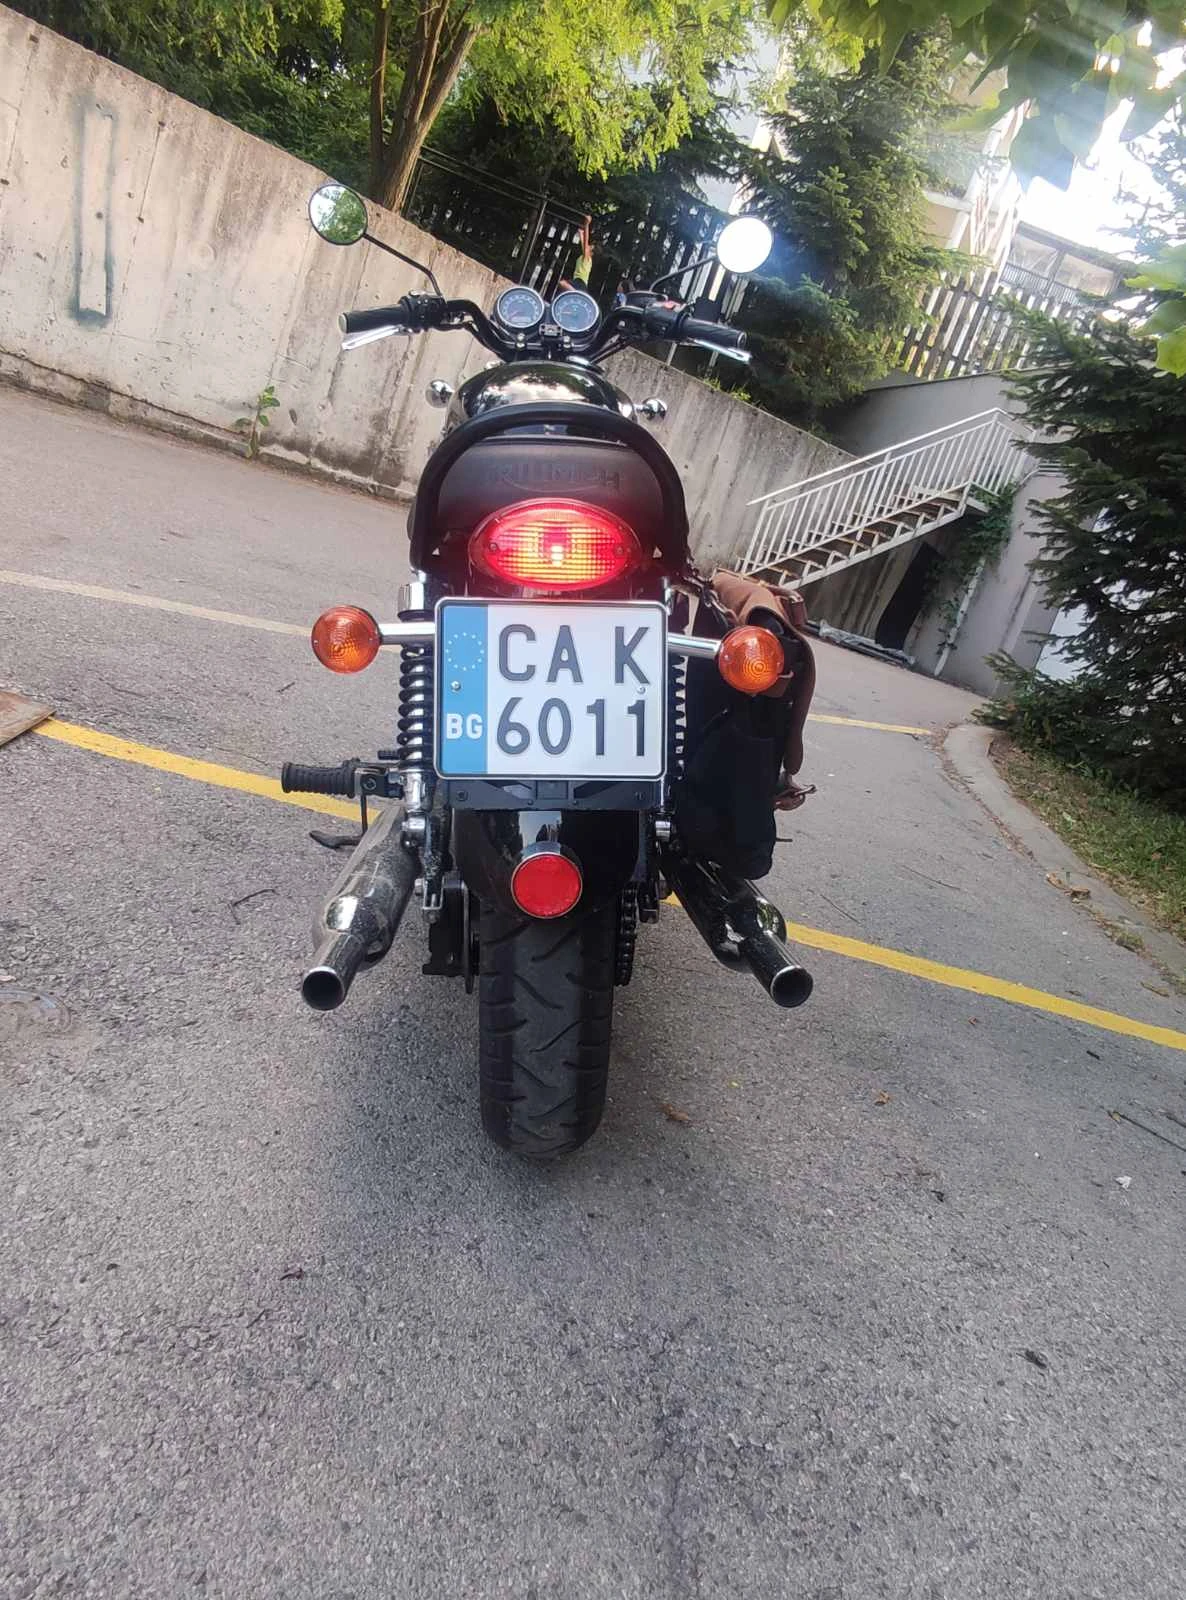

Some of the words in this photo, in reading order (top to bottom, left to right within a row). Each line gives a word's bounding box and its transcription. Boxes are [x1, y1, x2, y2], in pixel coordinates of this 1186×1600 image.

[499, 623, 583, 683] CA
[614, 626, 650, 684] K
[446, 713, 483, 739] BG
[497, 697, 646, 756] 6011
